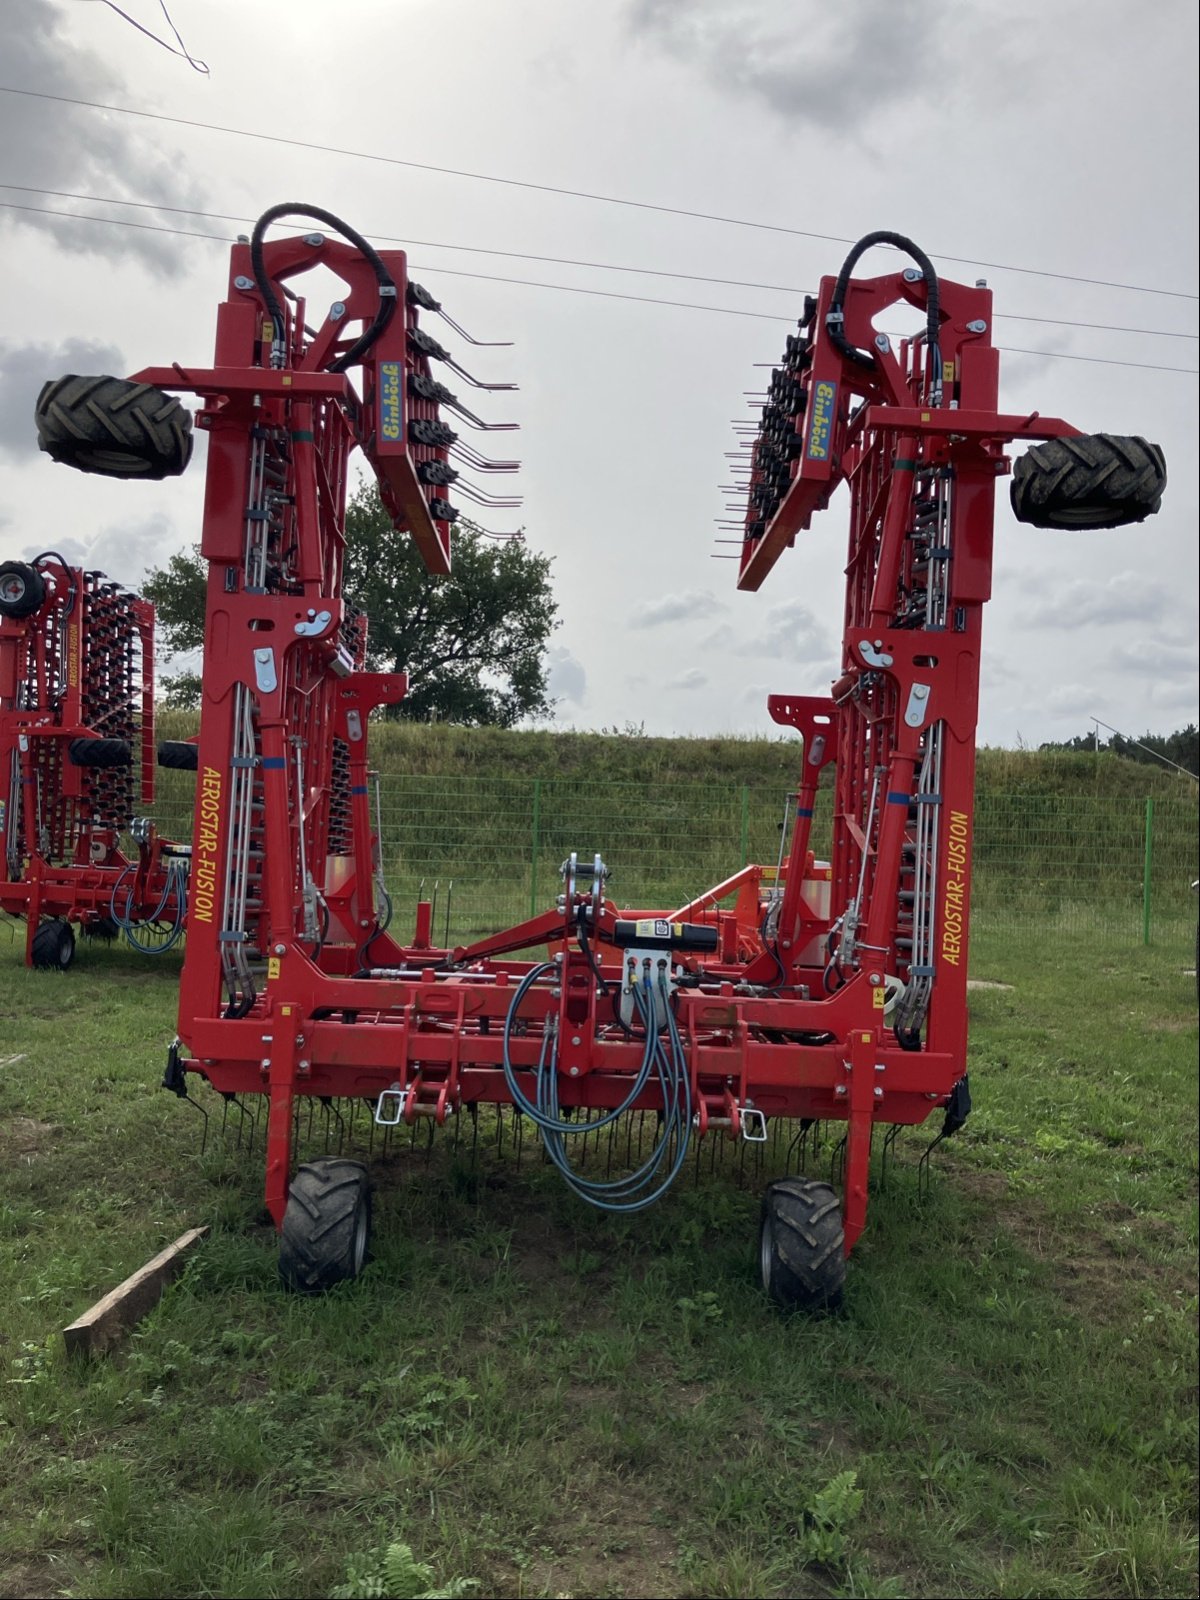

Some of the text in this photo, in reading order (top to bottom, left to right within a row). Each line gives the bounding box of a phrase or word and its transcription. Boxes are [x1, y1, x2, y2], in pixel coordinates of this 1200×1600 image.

[382, 364, 399, 438] Einböck
[809, 383, 833, 457] Einböck
[69, 623, 78, 688] AEROSTAR-FUSION
[194, 766, 222, 923] AEROSTAR-FUSION
[942, 810, 968, 966] AEROSTAR-FUSION
